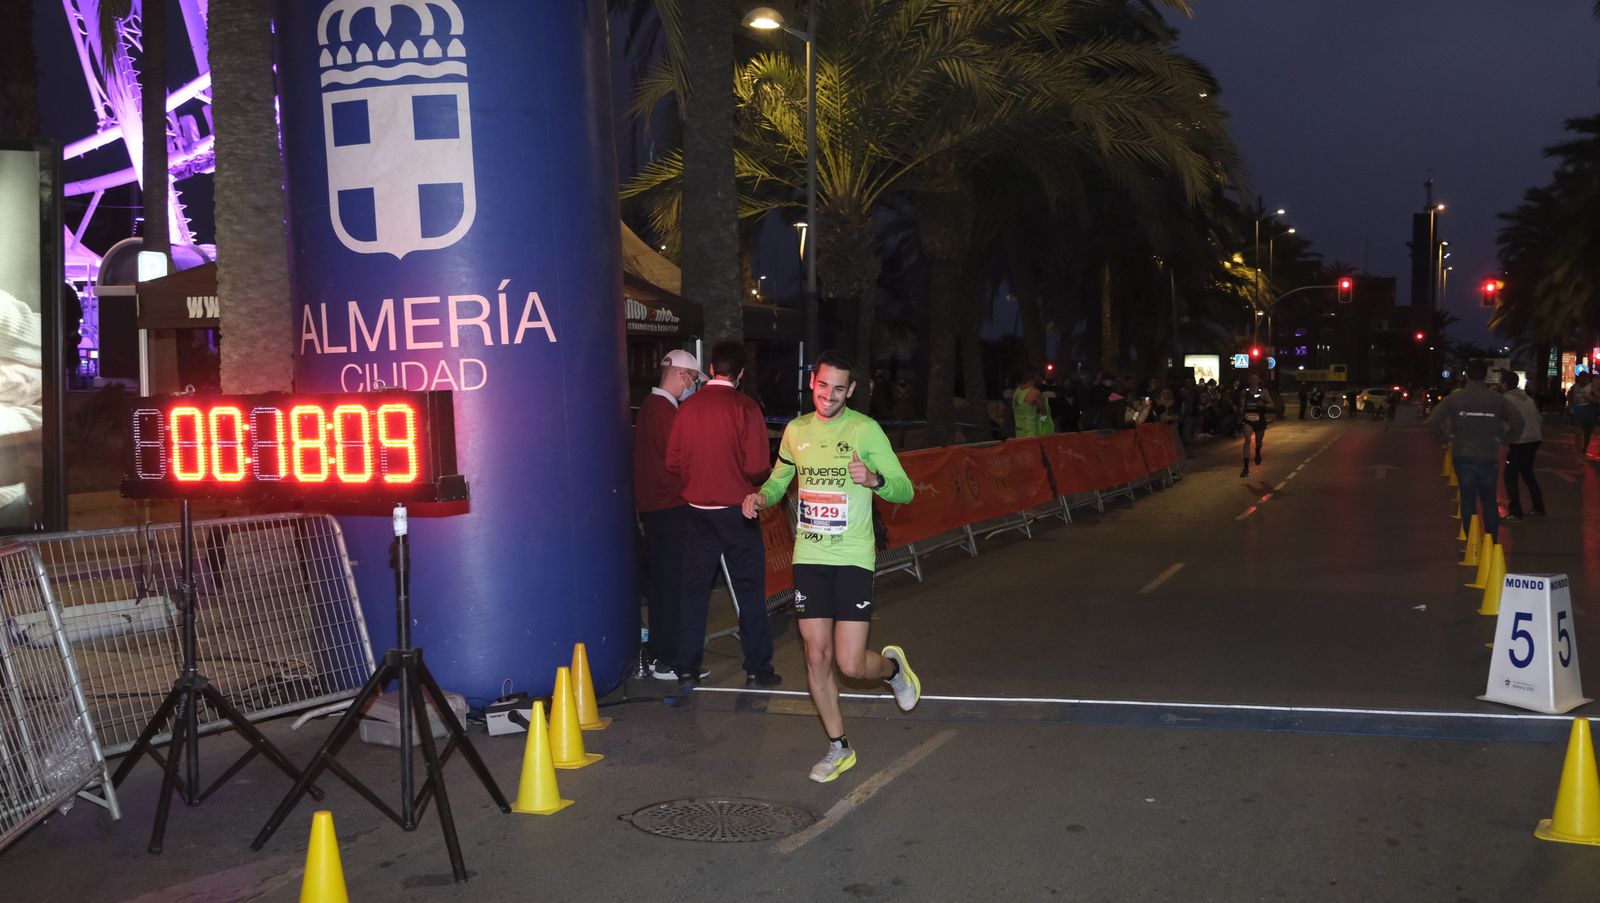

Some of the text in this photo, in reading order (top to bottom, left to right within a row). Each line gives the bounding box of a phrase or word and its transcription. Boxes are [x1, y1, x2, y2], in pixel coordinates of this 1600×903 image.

[300, 279, 557, 355] ALMERÍA
[340, 358, 488, 393] CIUDAD
[169, 403, 417, 483] 00:18:09
[805, 477, 847, 487] Running
[804, 504, 840, 518] 3129
[1505, 578, 1544, 591] MONDO
[1550, 577, 1568, 591] MONDO
[1508, 612, 1535, 669] 5
[1557, 610, 1571, 668] 5
